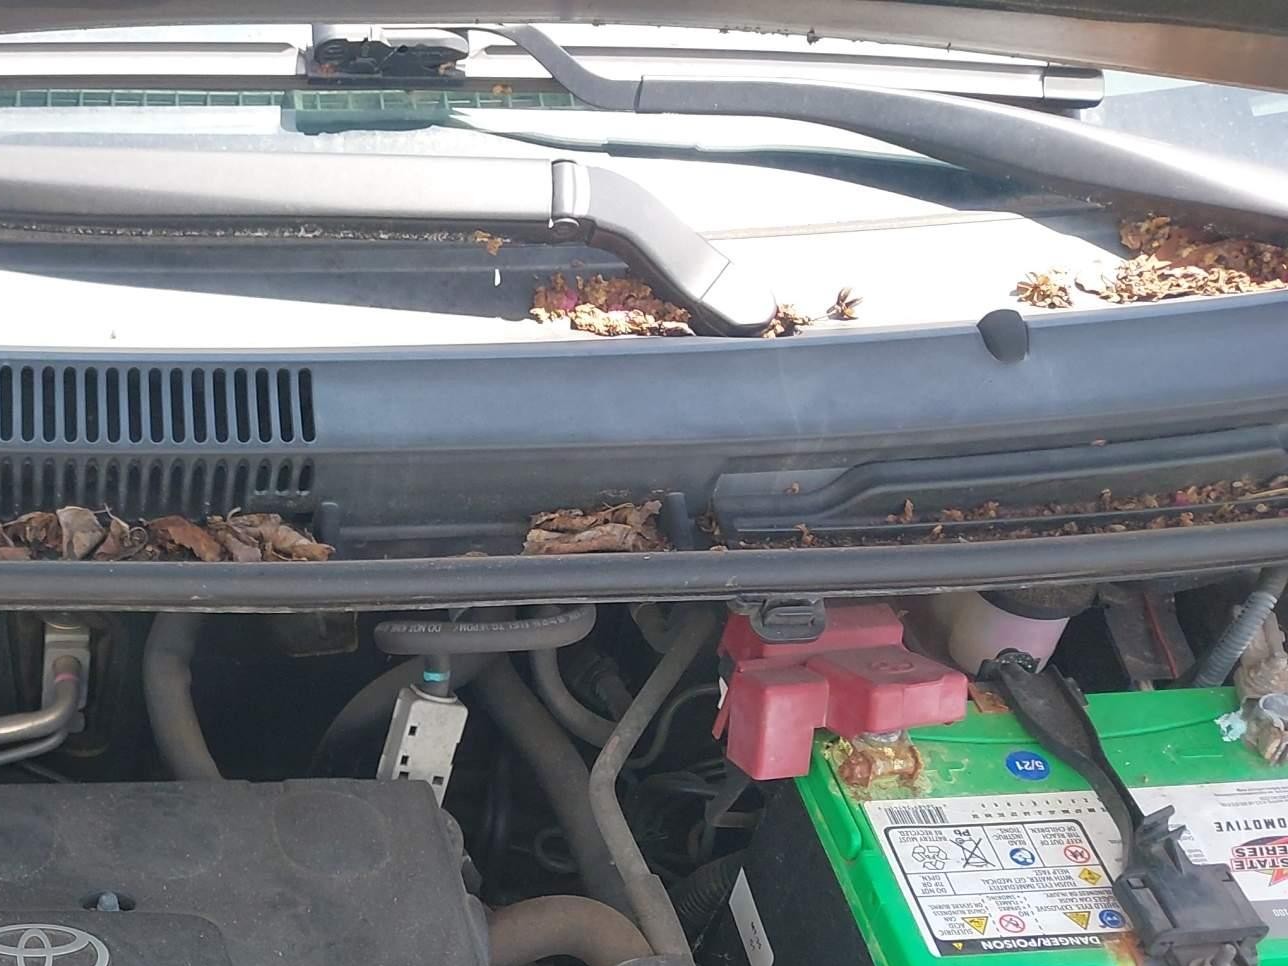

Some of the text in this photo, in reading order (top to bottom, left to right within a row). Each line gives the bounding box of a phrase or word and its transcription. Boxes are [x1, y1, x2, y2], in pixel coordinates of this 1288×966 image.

[1016, 760, 1045, 771] 5/21
[953, 829, 971, 837] Pb
[981, 936, 1101, 950] DANGER/POISON
